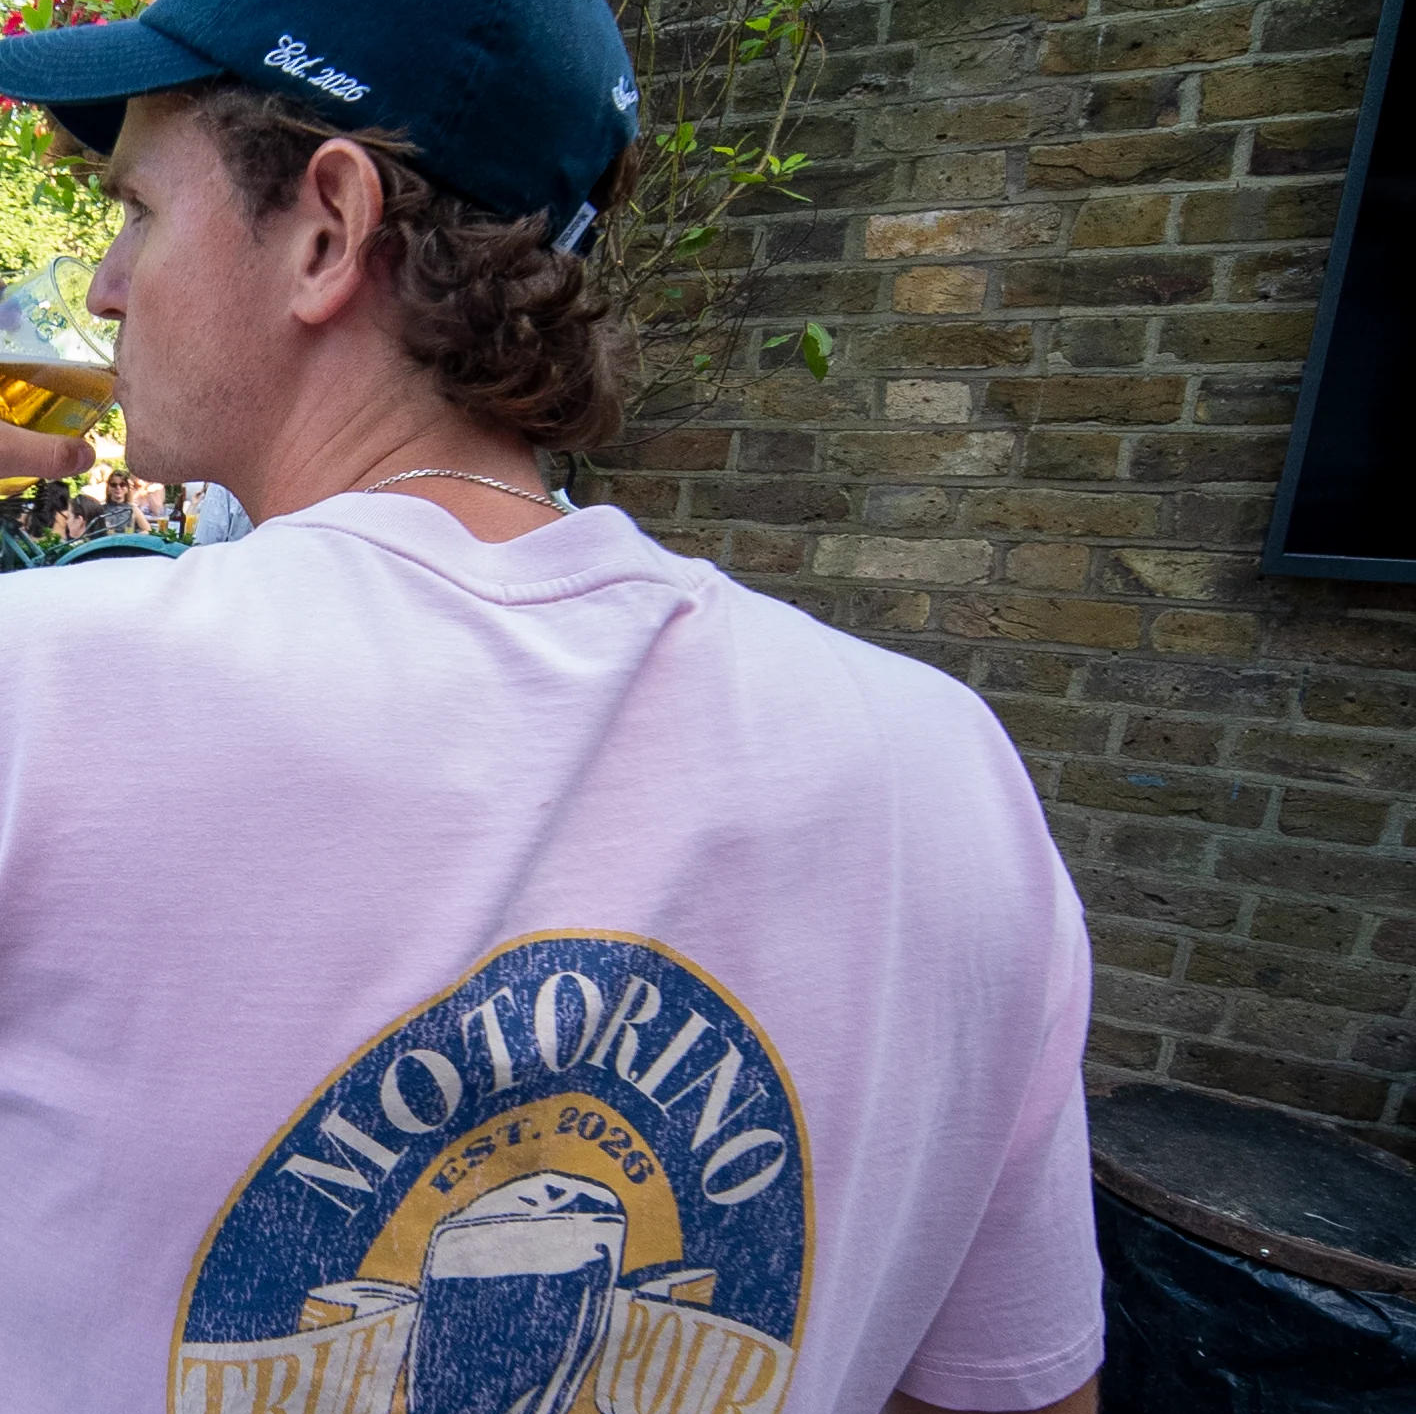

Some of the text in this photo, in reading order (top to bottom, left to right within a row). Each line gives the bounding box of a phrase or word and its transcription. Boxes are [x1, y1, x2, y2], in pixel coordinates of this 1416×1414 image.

[264, 34, 371, 102] Est. 2026
[277, 971, 786, 1222] MOTORINO
[430, 1106, 656, 1194] EST. 2026
